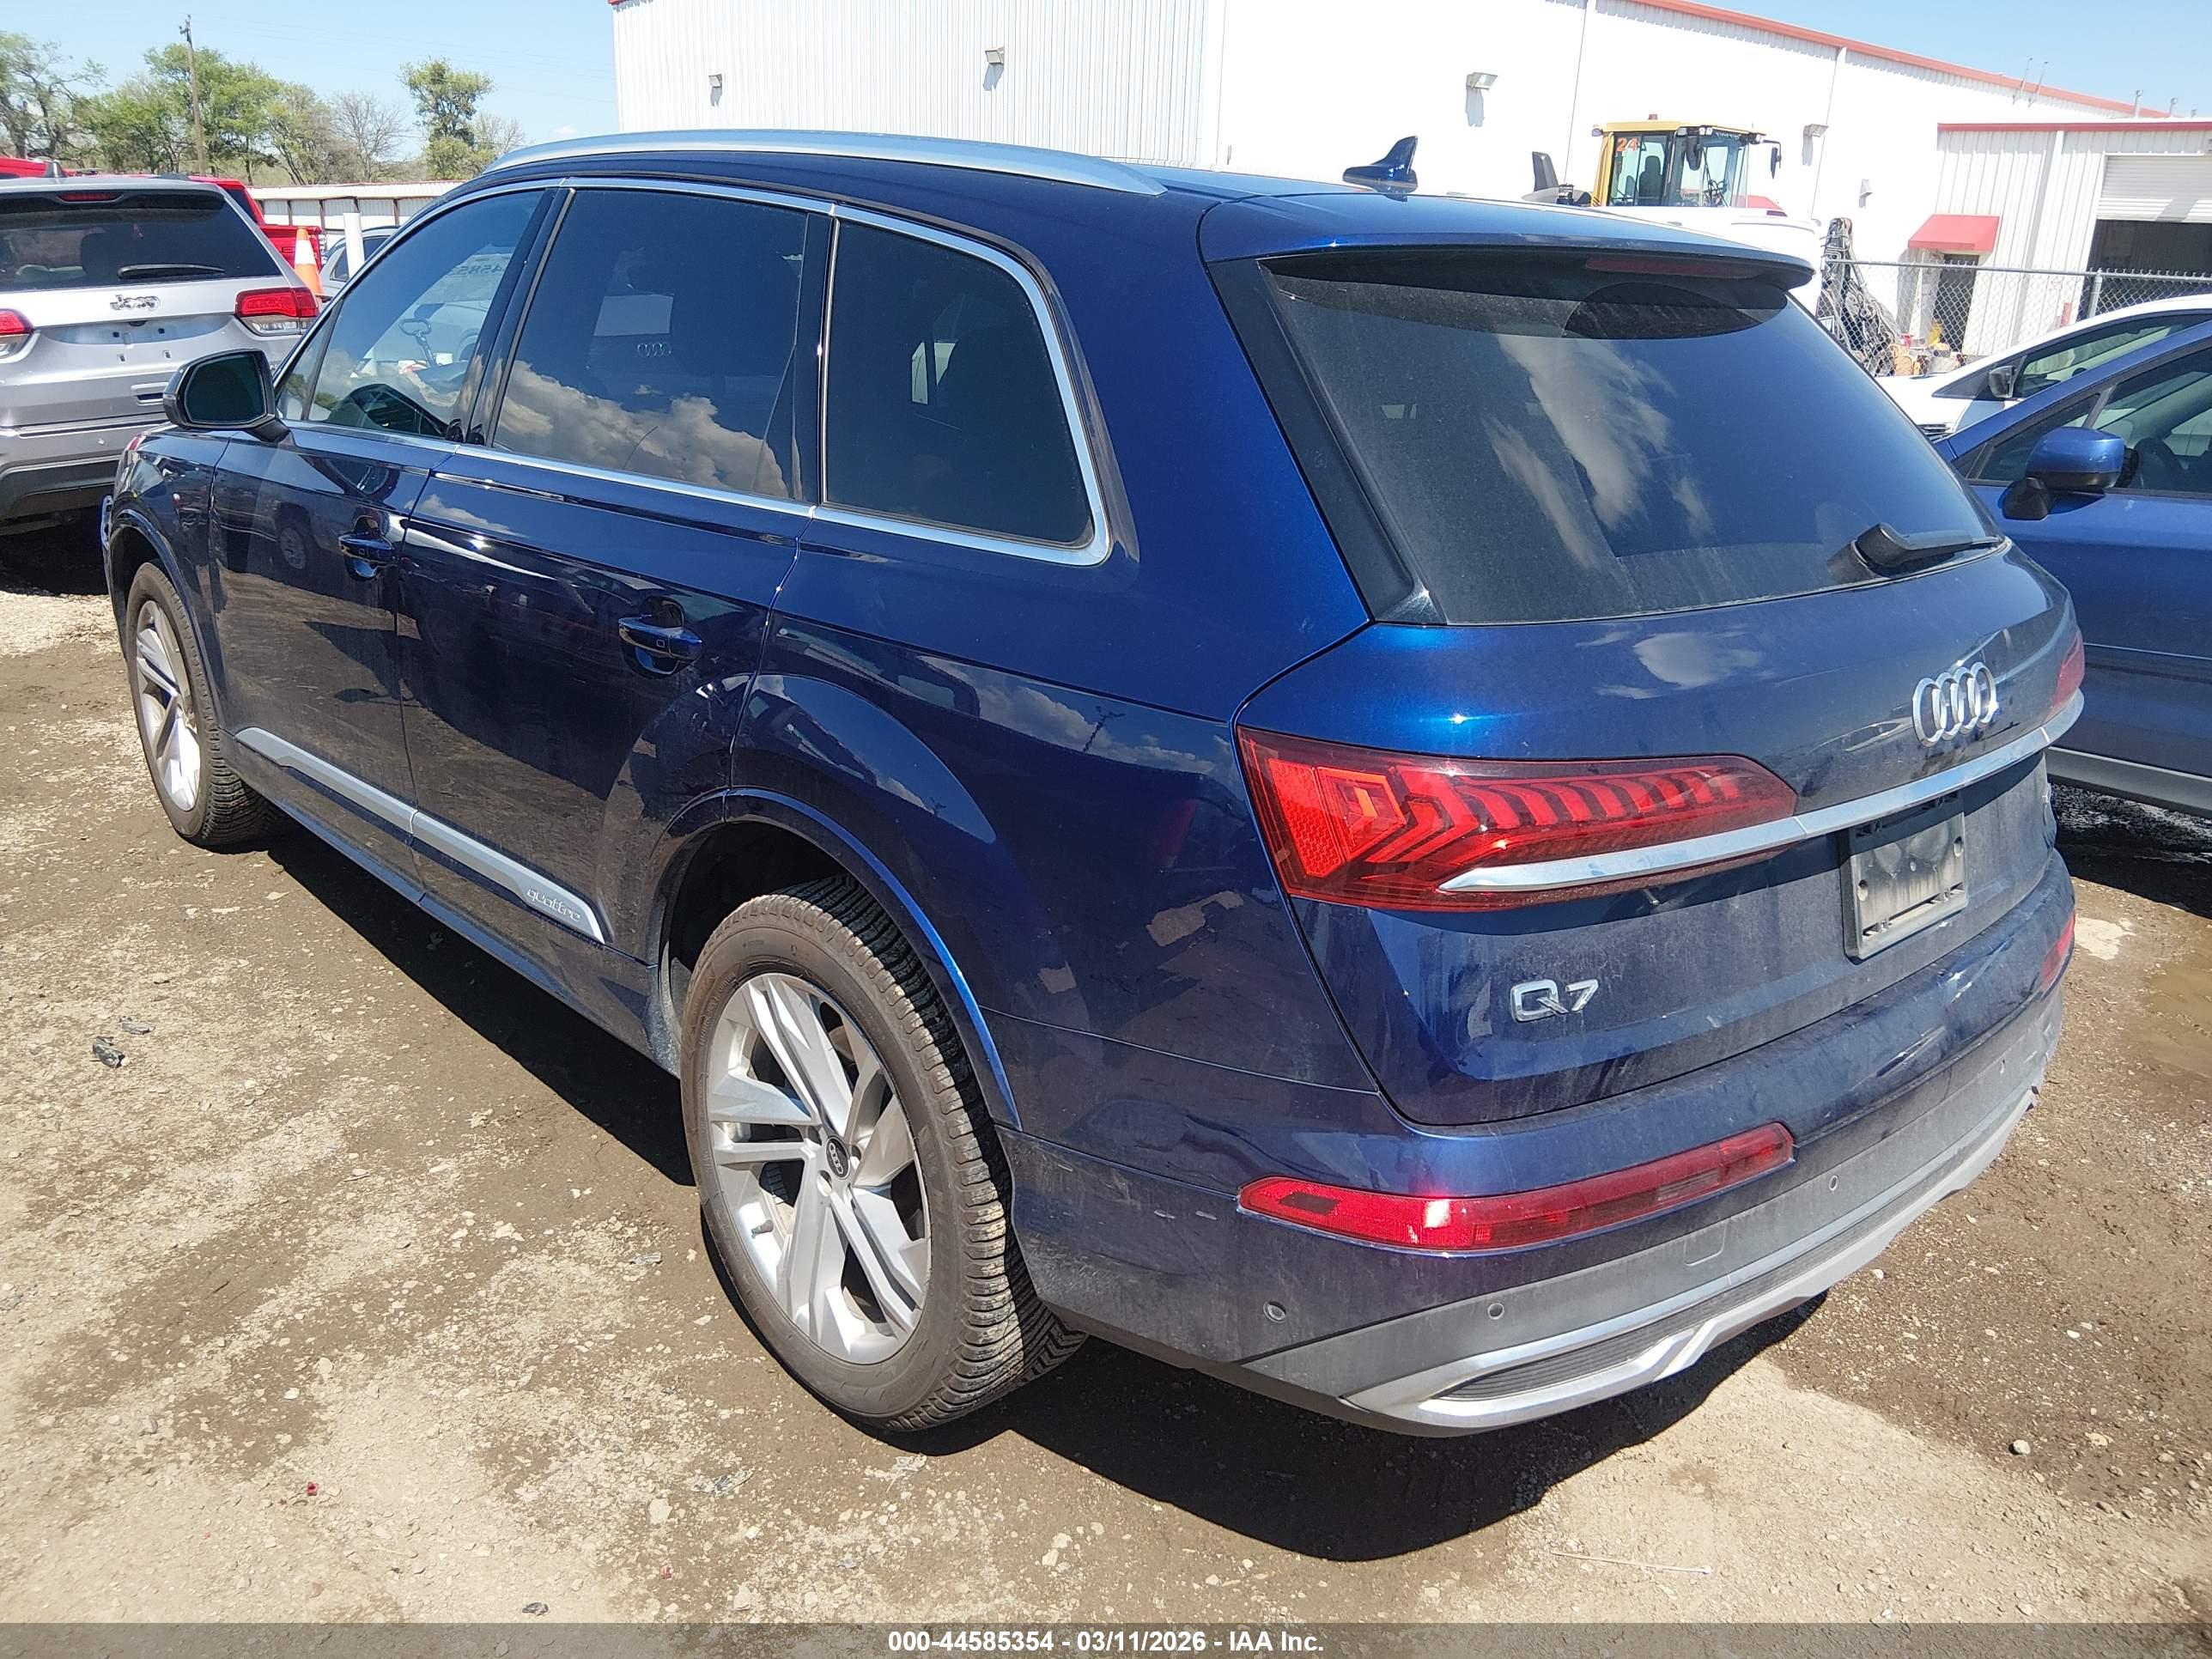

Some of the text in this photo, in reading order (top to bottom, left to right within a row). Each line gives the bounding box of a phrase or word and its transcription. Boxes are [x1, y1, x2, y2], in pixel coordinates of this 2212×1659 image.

[1616, 137, 1639, 152] 24
[109, 294, 162, 312] Jeep
[526, 888, 581, 922] quattro
[1510, 978, 1599, 1023] Q7
